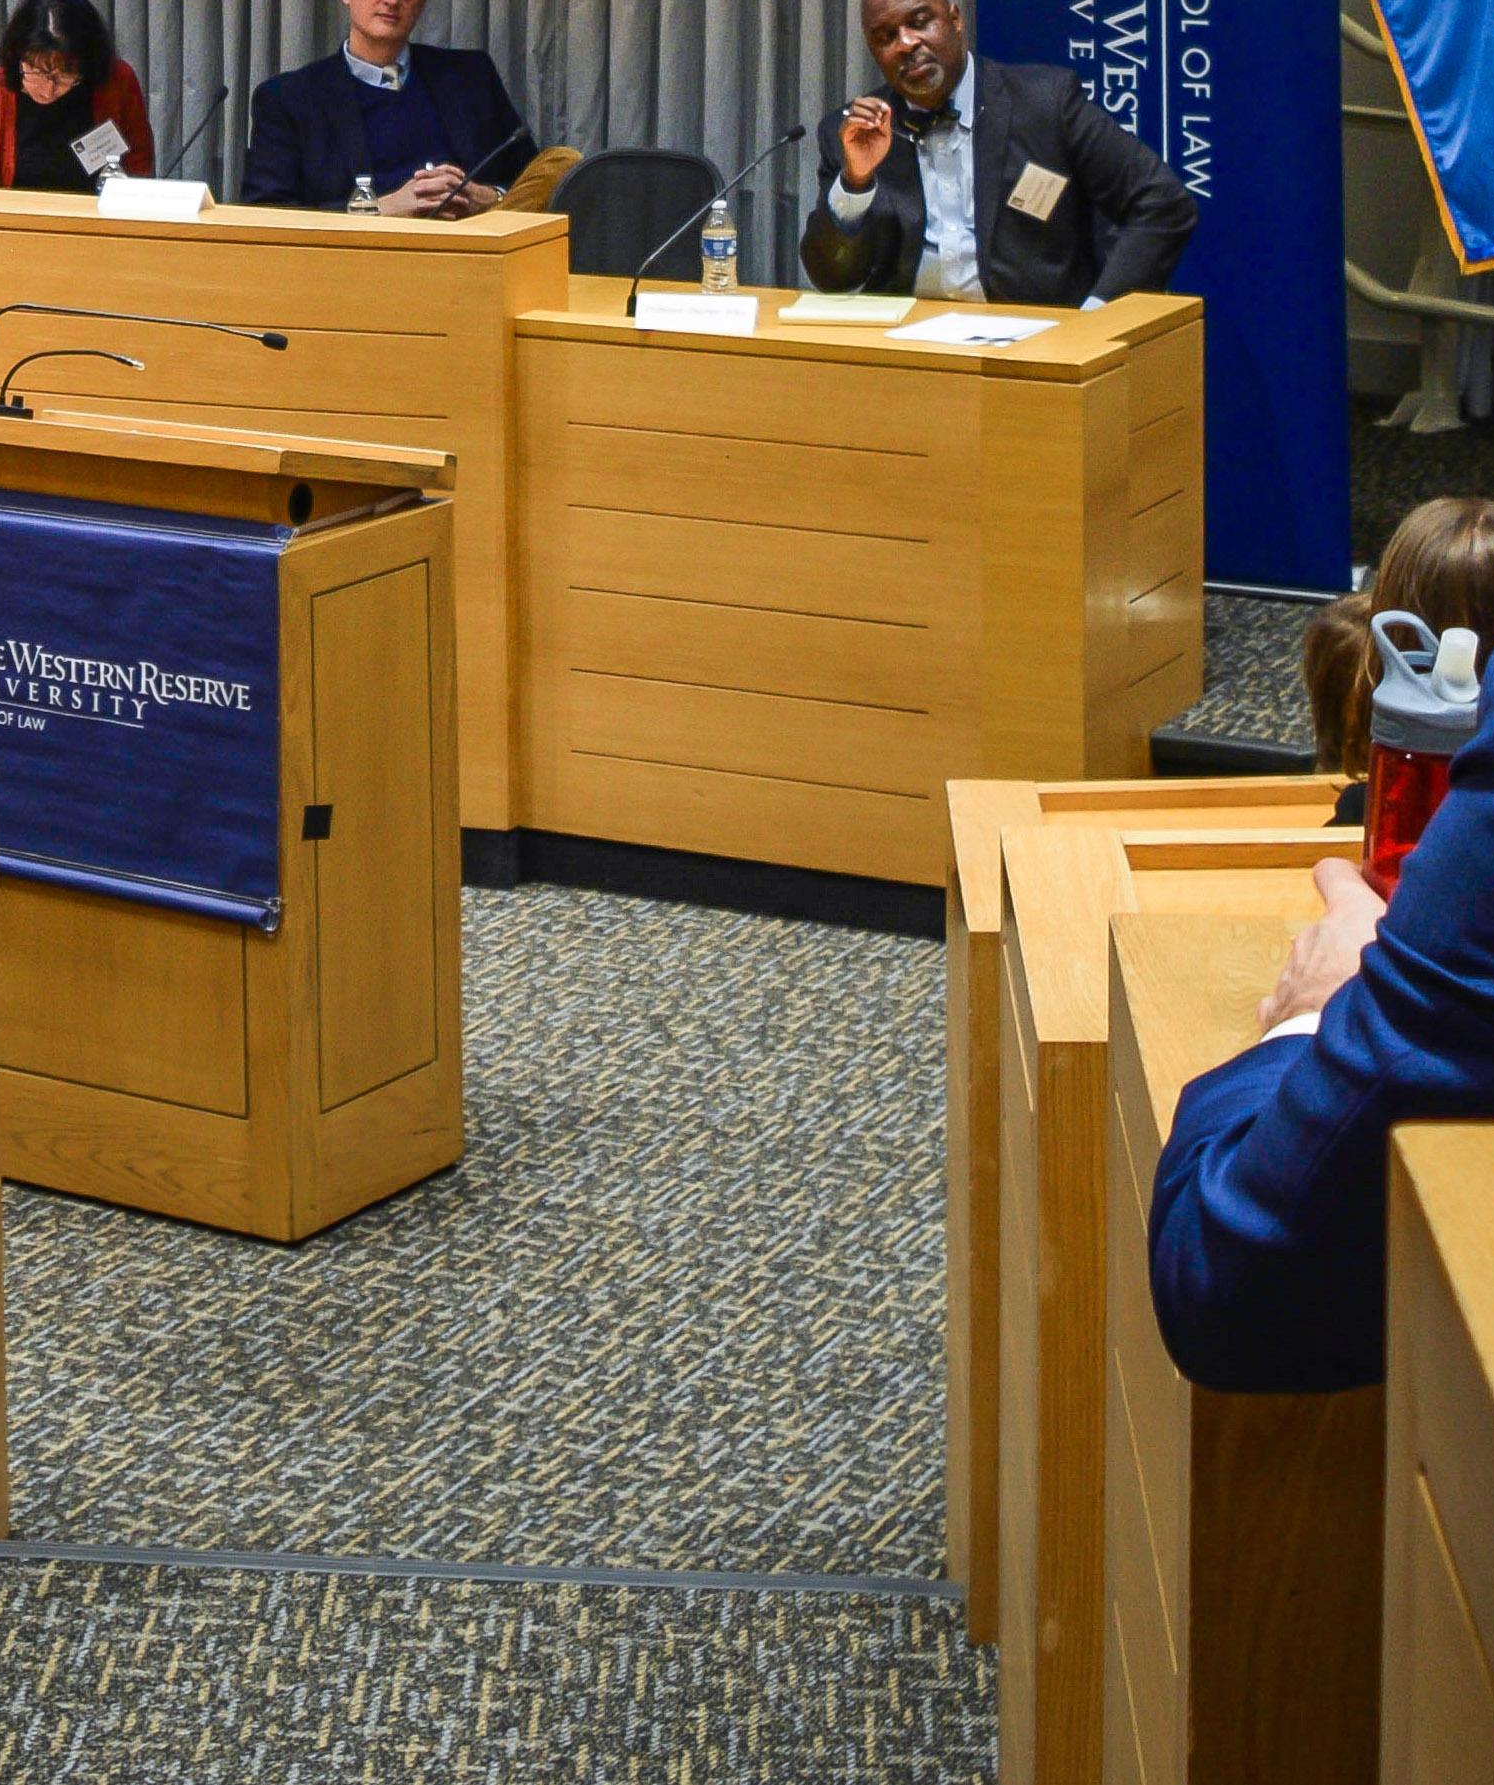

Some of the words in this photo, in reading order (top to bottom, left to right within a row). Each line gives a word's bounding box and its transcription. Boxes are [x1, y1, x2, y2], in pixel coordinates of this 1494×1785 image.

[1181, 48, 1211, 99] OF
[1182, 115, 1212, 198] LAW
[18, 714, 46, 731] LAW
